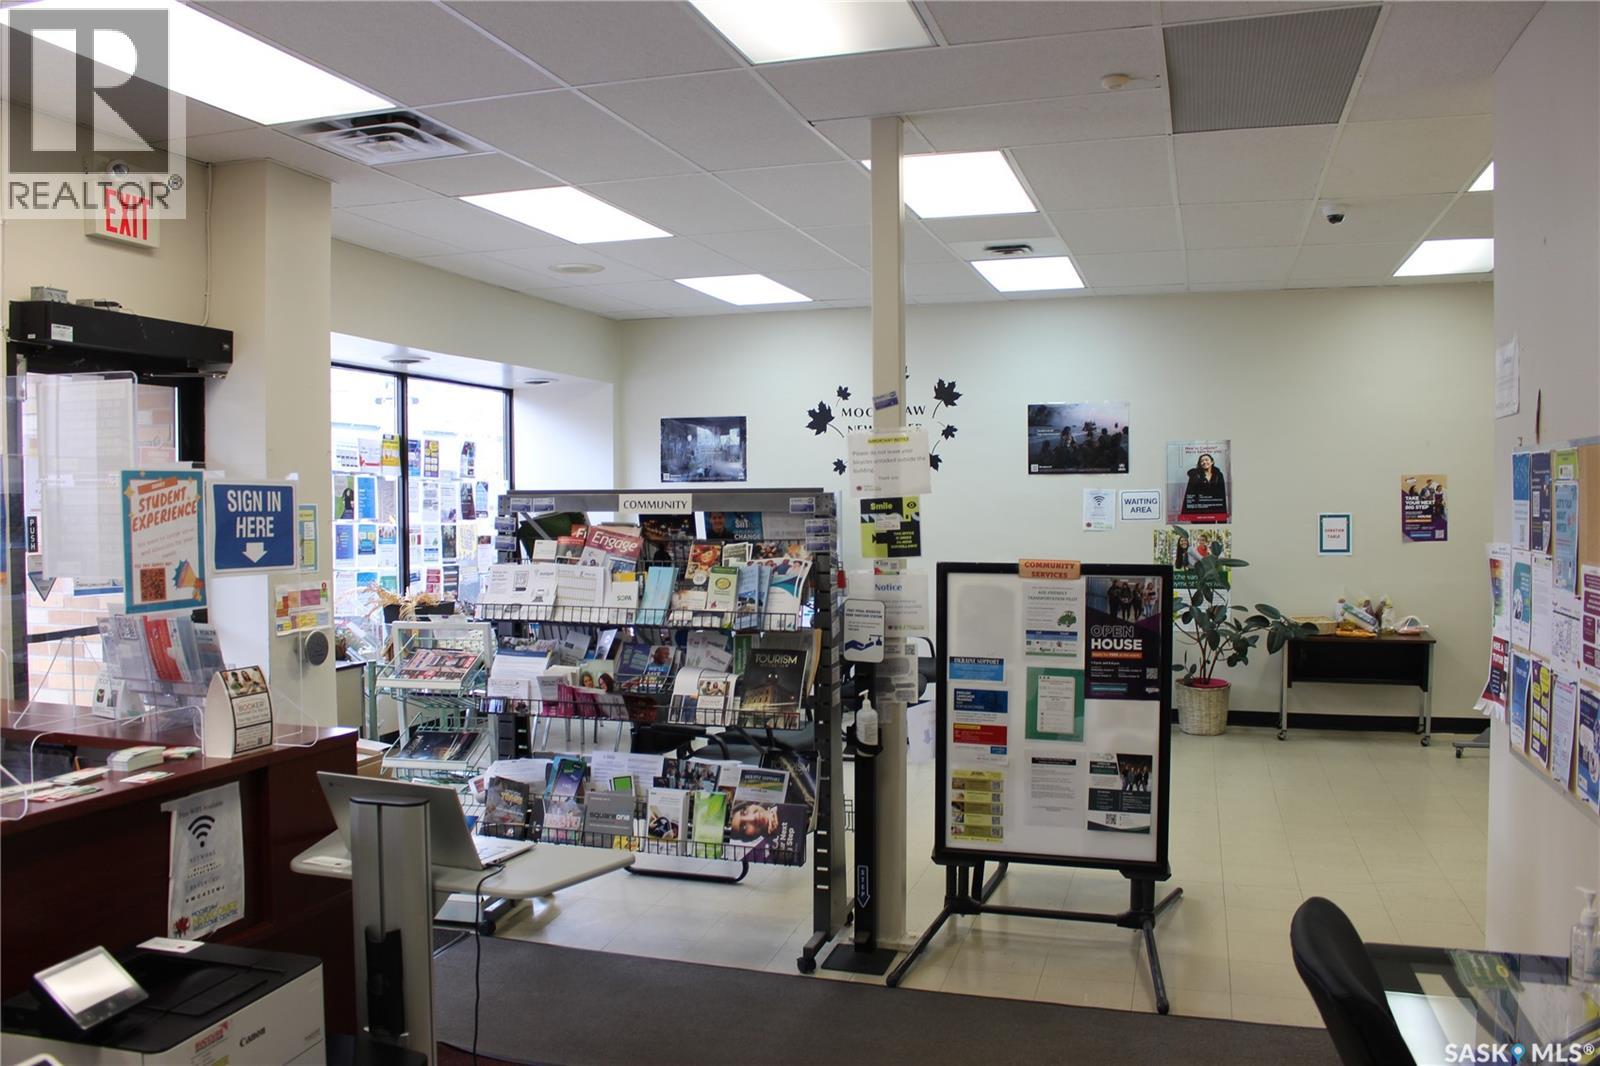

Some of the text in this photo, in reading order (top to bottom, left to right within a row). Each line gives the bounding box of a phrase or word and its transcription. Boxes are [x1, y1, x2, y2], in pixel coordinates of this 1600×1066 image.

[105, 187, 149, 241] EXIT
[138, 486, 187, 513] STUDENT
[226, 489, 282, 513] SIGN IN
[623, 500, 688, 510] COMMUNITY
[870, 502, 893, 511] Smile
[1124, 498, 1158, 506] WAITING
[132, 500, 198, 533] EXPERIENCE
[29, 519, 37, 550] PUSH
[236, 517, 274, 538] HERE
[591, 531, 639, 552] Engage
[1024, 561, 1075, 569] COMMUNITY
[1031, 571, 1068, 579] SERVICES
[874, 583, 903, 592] Notice
[1090, 624, 1135, 638] OPEN
[1090, 638, 1143, 650] HOUSE
[755, 653, 798, 665] TOURISM
[787, 827, 795, 846] Step
[239, 1027, 266, 1048] Canon
